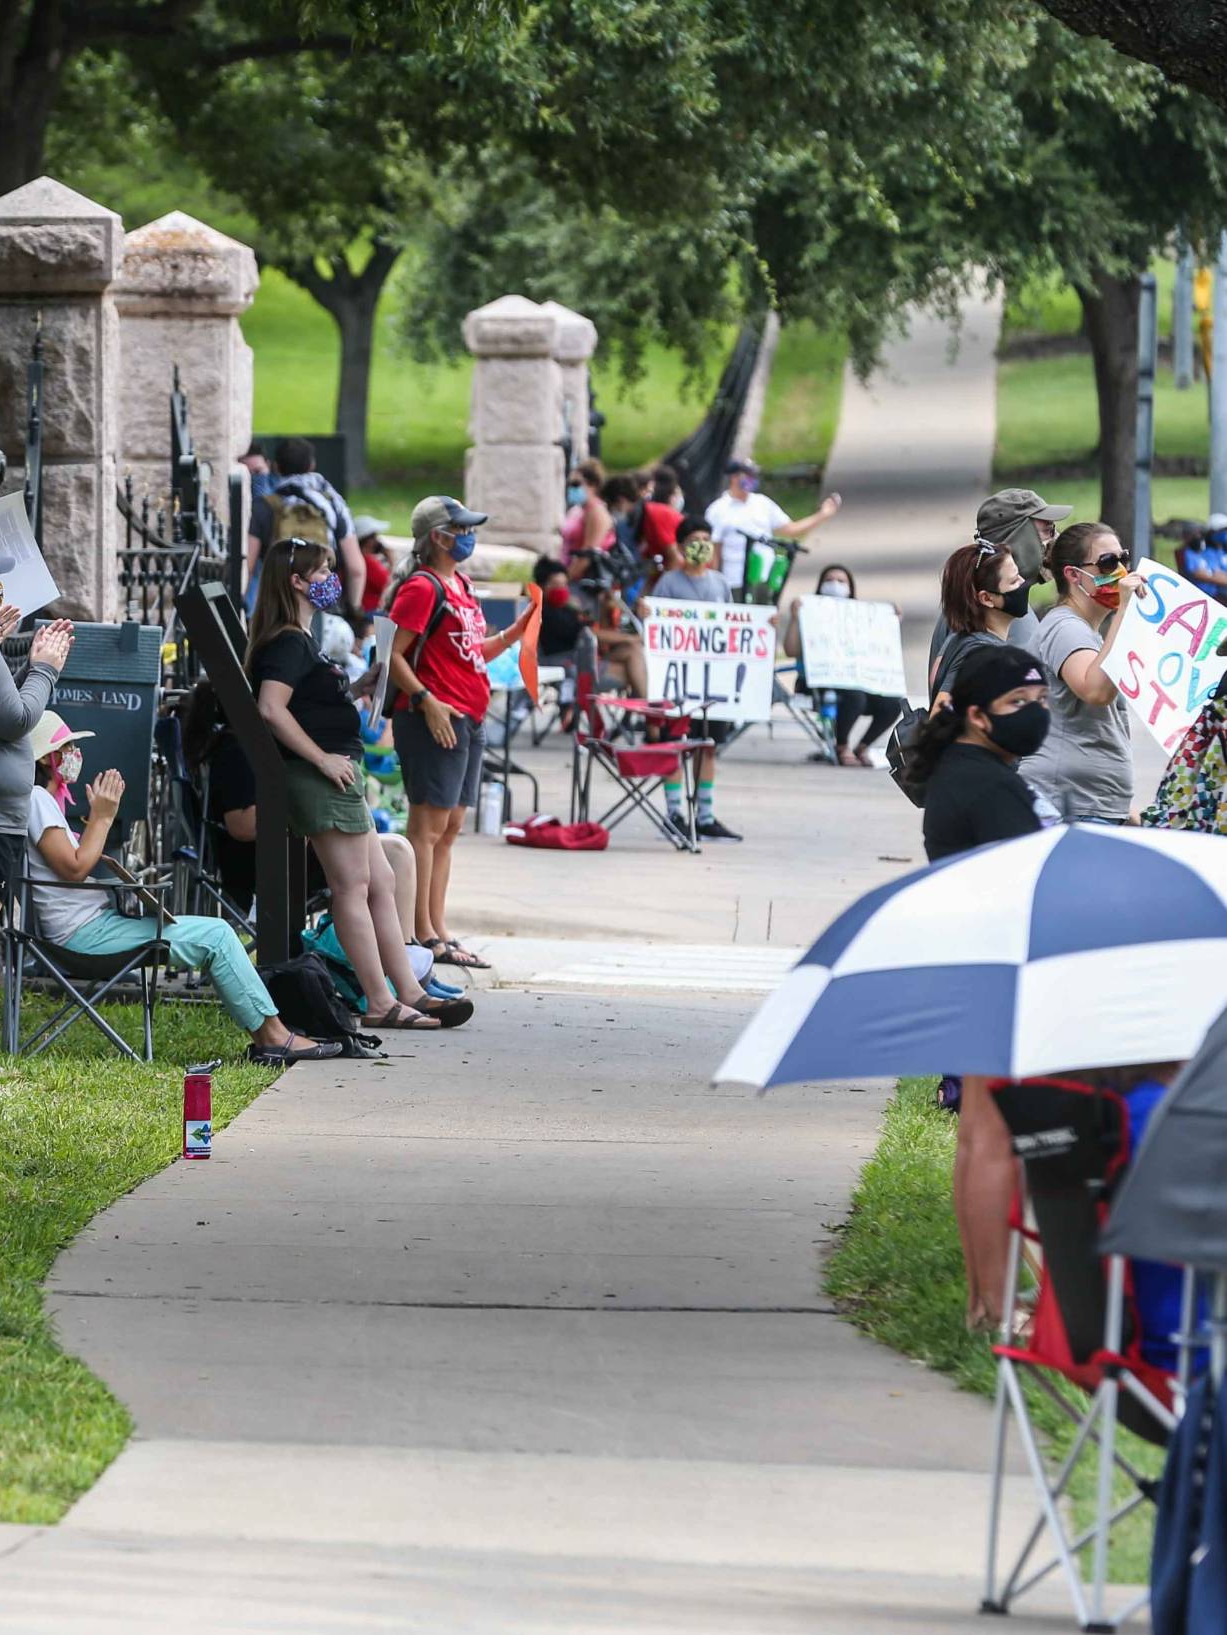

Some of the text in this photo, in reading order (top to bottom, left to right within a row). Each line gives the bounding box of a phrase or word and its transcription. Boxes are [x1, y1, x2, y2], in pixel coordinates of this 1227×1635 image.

[655, 607, 699, 620] SCHOOL
[647, 622, 768, 658] ENDANGERS
[662, 660, 747, 704] ALL!
[101, 691, 142, 711] LAND
